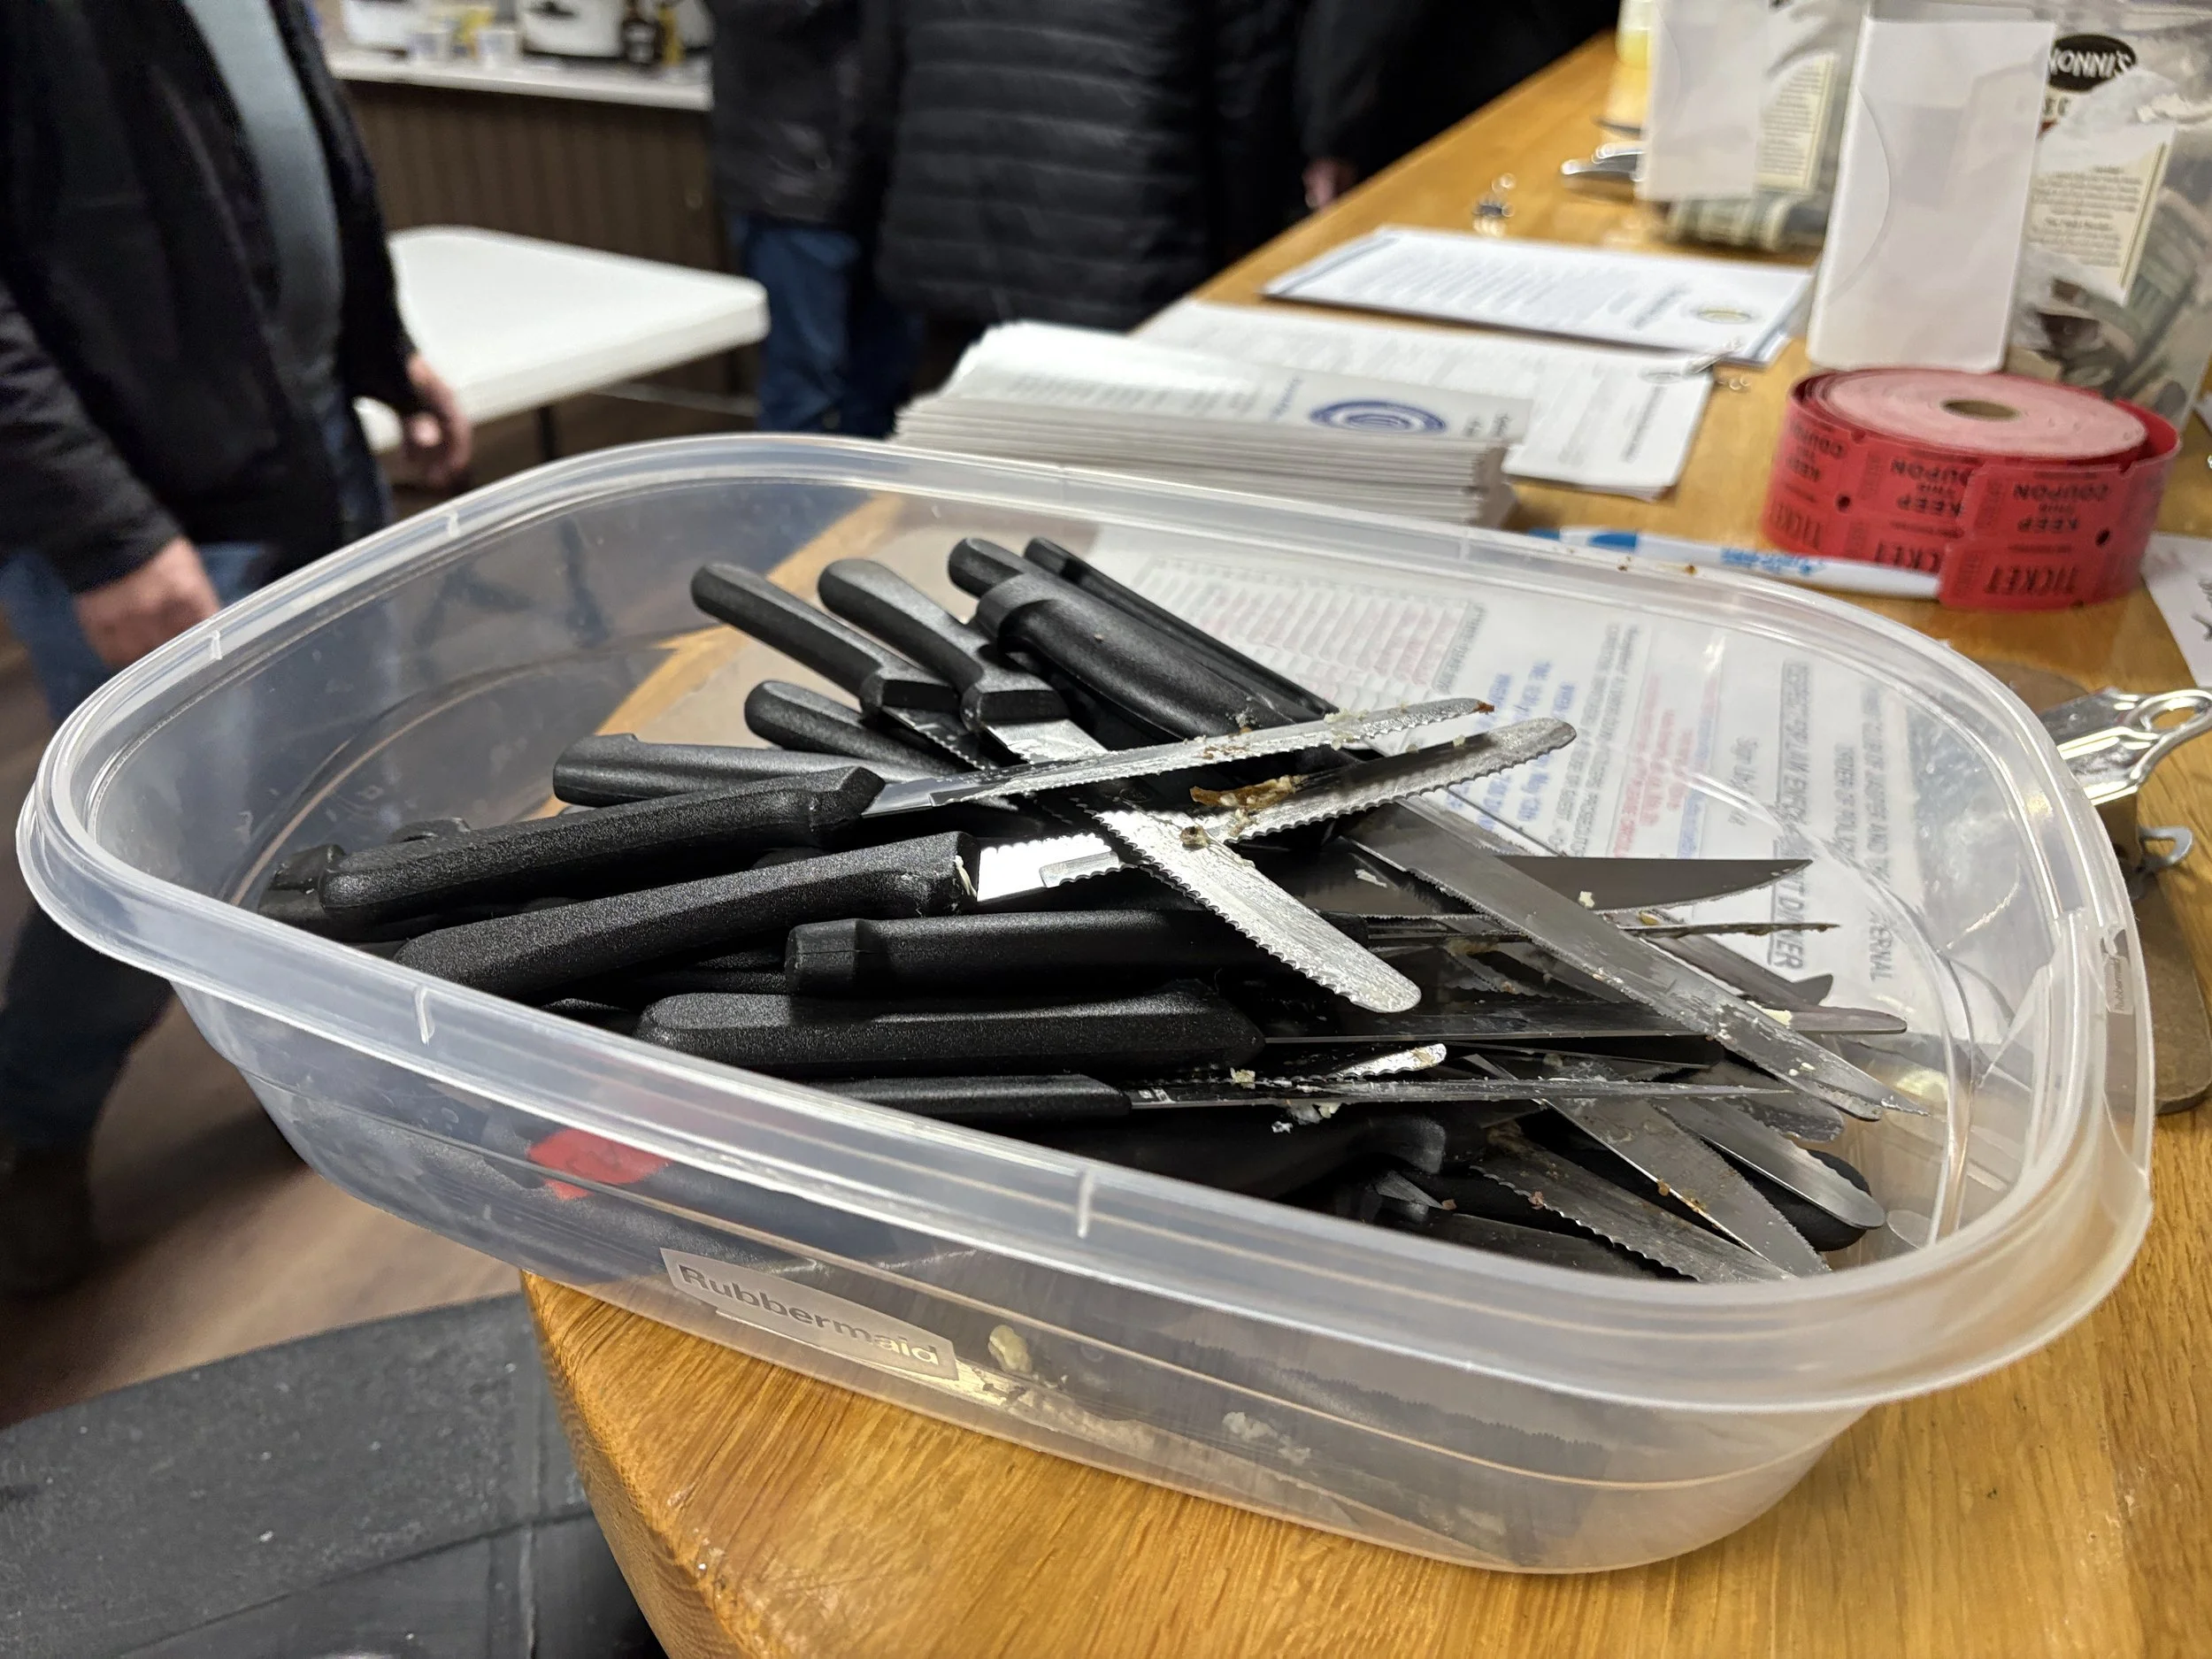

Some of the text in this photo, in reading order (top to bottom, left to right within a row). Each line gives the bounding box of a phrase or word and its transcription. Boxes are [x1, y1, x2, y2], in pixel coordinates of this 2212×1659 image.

[1888, 457, 1974, 488] OUPON
[1897, 494, 1963, 518] KEEP
[2016, 516, 2079, 533] KEEP
[1875, 541, 1945, 573] CKET
[1984, 565, 2080, 596] TICKET
[678, 1263, 941, 1366] Rubbermaid
